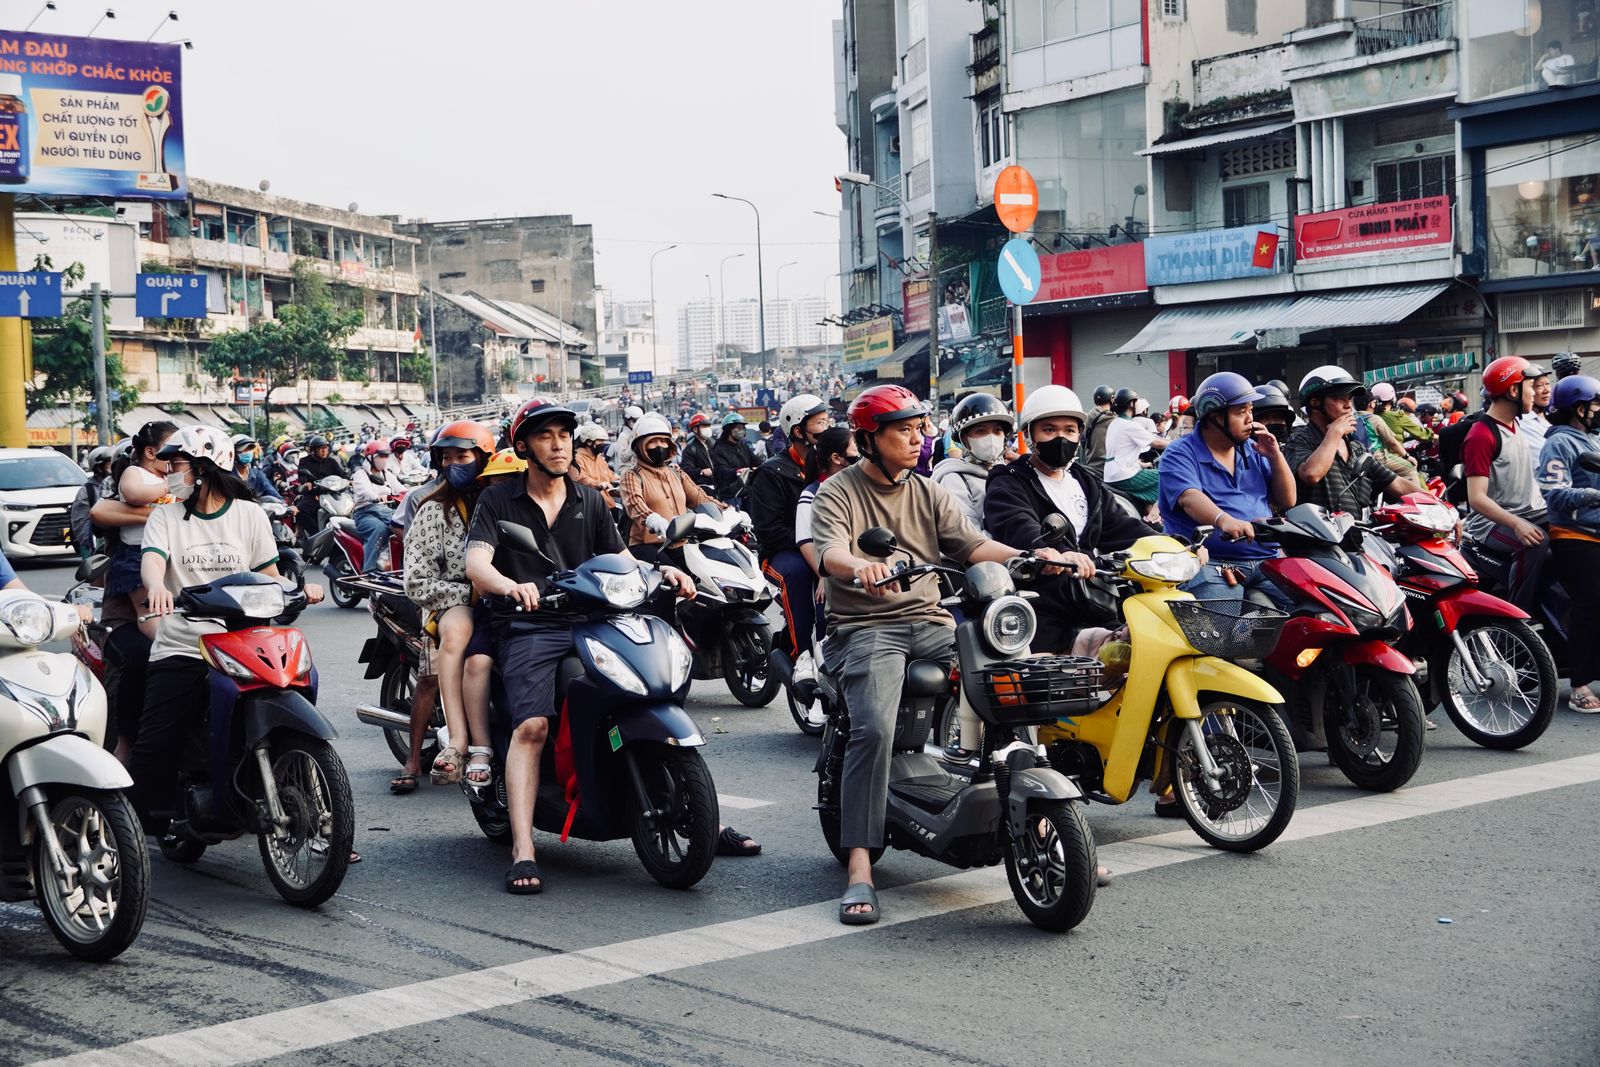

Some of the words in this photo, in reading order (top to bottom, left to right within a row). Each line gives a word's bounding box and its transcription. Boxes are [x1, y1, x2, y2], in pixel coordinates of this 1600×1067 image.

[24, 41, 68, 58] ĐAU
[30, 60, 78, 76] KHỚP
[82, 62, 125, 80] CHẮC
[129, 66, 173, 83] KHỎE
[60, 95, 83, 108] SẢN
[87, 95, 120, 111] PHẨM
[42, 110, 73, 124] CHẤT
[77, 114, 115, 129] LƯỢNG
[119, 114, 138, 128] TỐT
[54, 128, 65, 140] VÌ
[69, 128, 107, 143] QUYỀN
[111, 134, 128, 148] LỢI
[41, 145, 80, 157] NGƯỜI
[83, 146, 105, 159] TIÊU
[109, 148, 142, 161] DÙNG
[1359, 220, 1391, 236] MINH
[1394, 212, 1428, 232] PHÁT
[1157, 248, 1217, 270] THANH
[0, 275, 37, 289] QUẬN
[44, 275, 51, 286] 1
[146, 277, 182, 290] QUẬN
[189, 278, 198, 288] 8
[182, 554, 206, 564] LOTS
